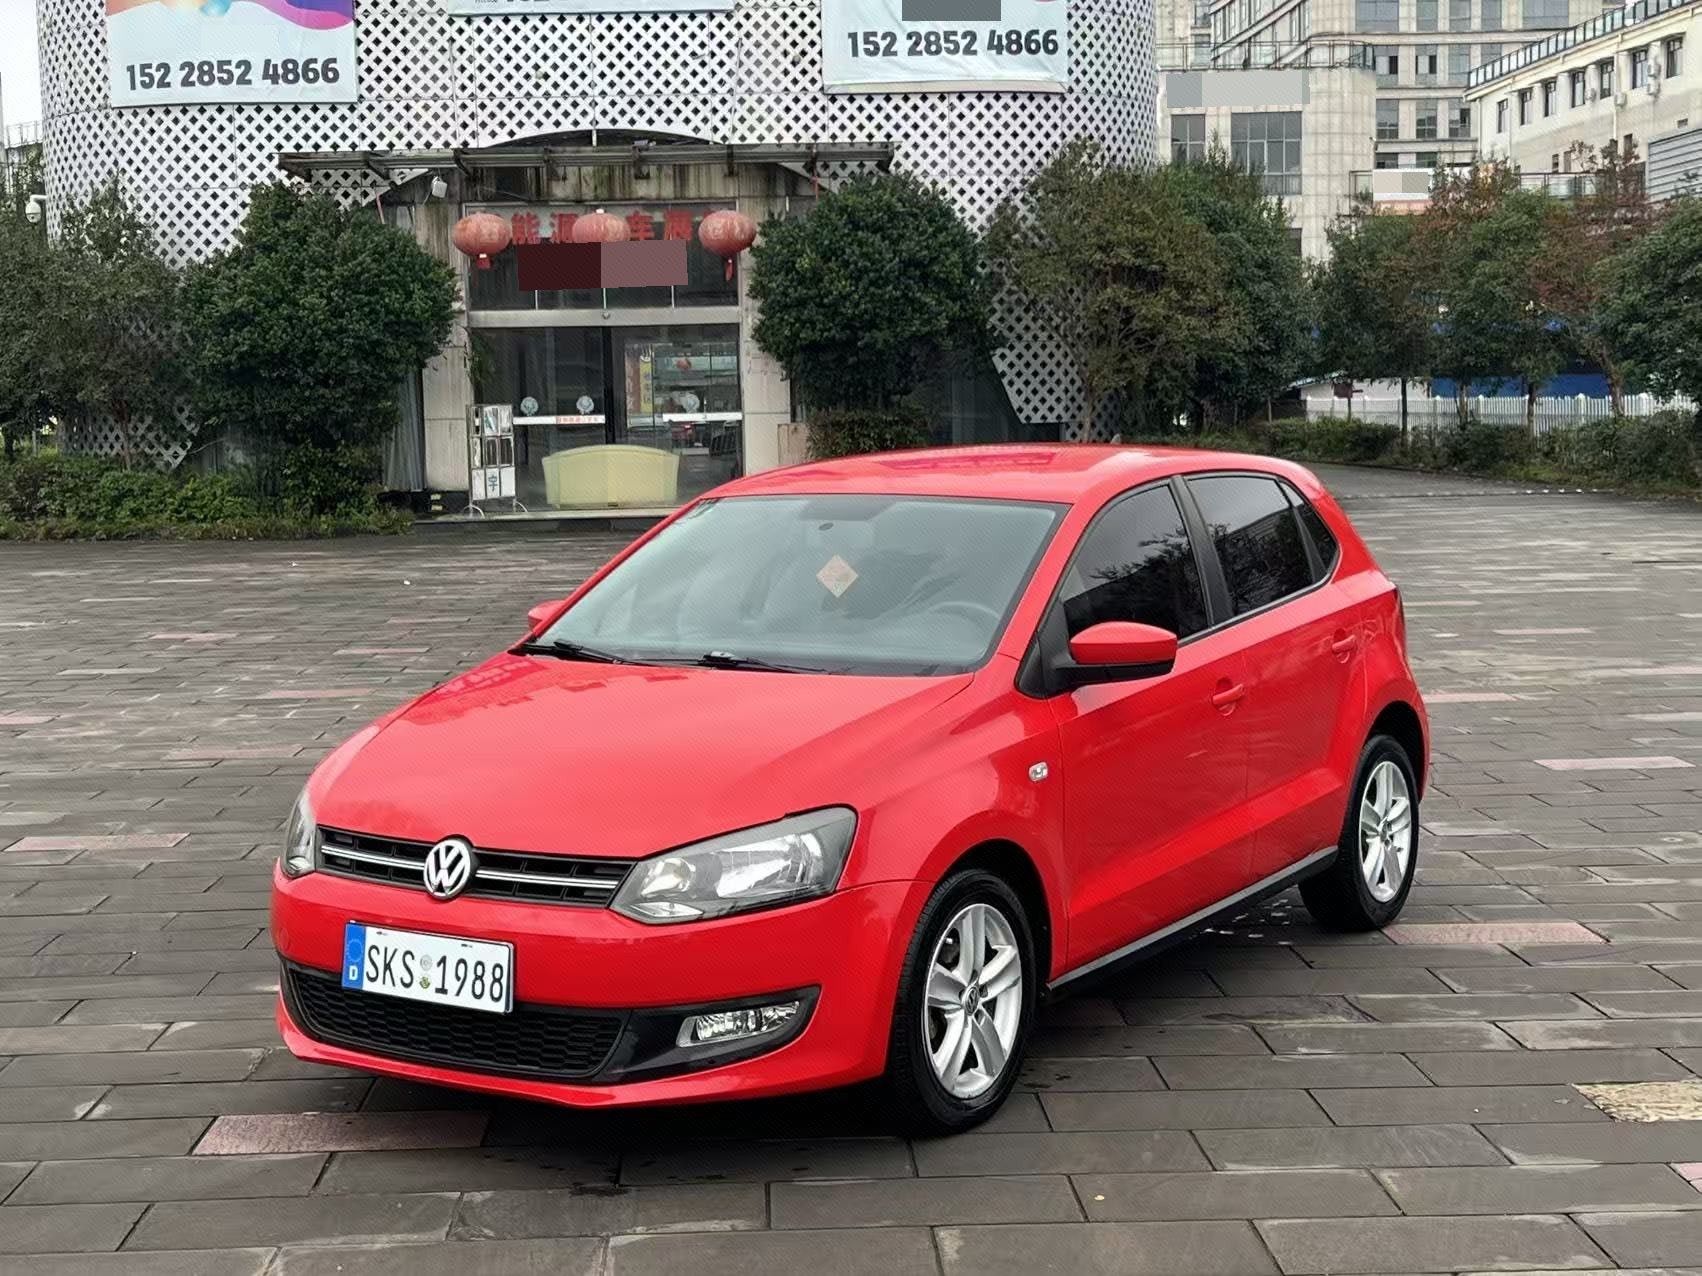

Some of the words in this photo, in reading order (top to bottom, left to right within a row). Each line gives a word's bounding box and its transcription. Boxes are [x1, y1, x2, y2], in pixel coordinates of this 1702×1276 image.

[848, 31, 898, 57] 152
[906, 30, 978, 56] 2852
[986, 29, 1059, 55] 4866
[126, 62, 171, 90] 152
[179, 60, 252, 87] 2852
[262, 57, 340, 85] 4866
[348, 965, 359, 981] D
[365, 944, 415, 989] SKS
[434, 954, 504, 1003] 1988
